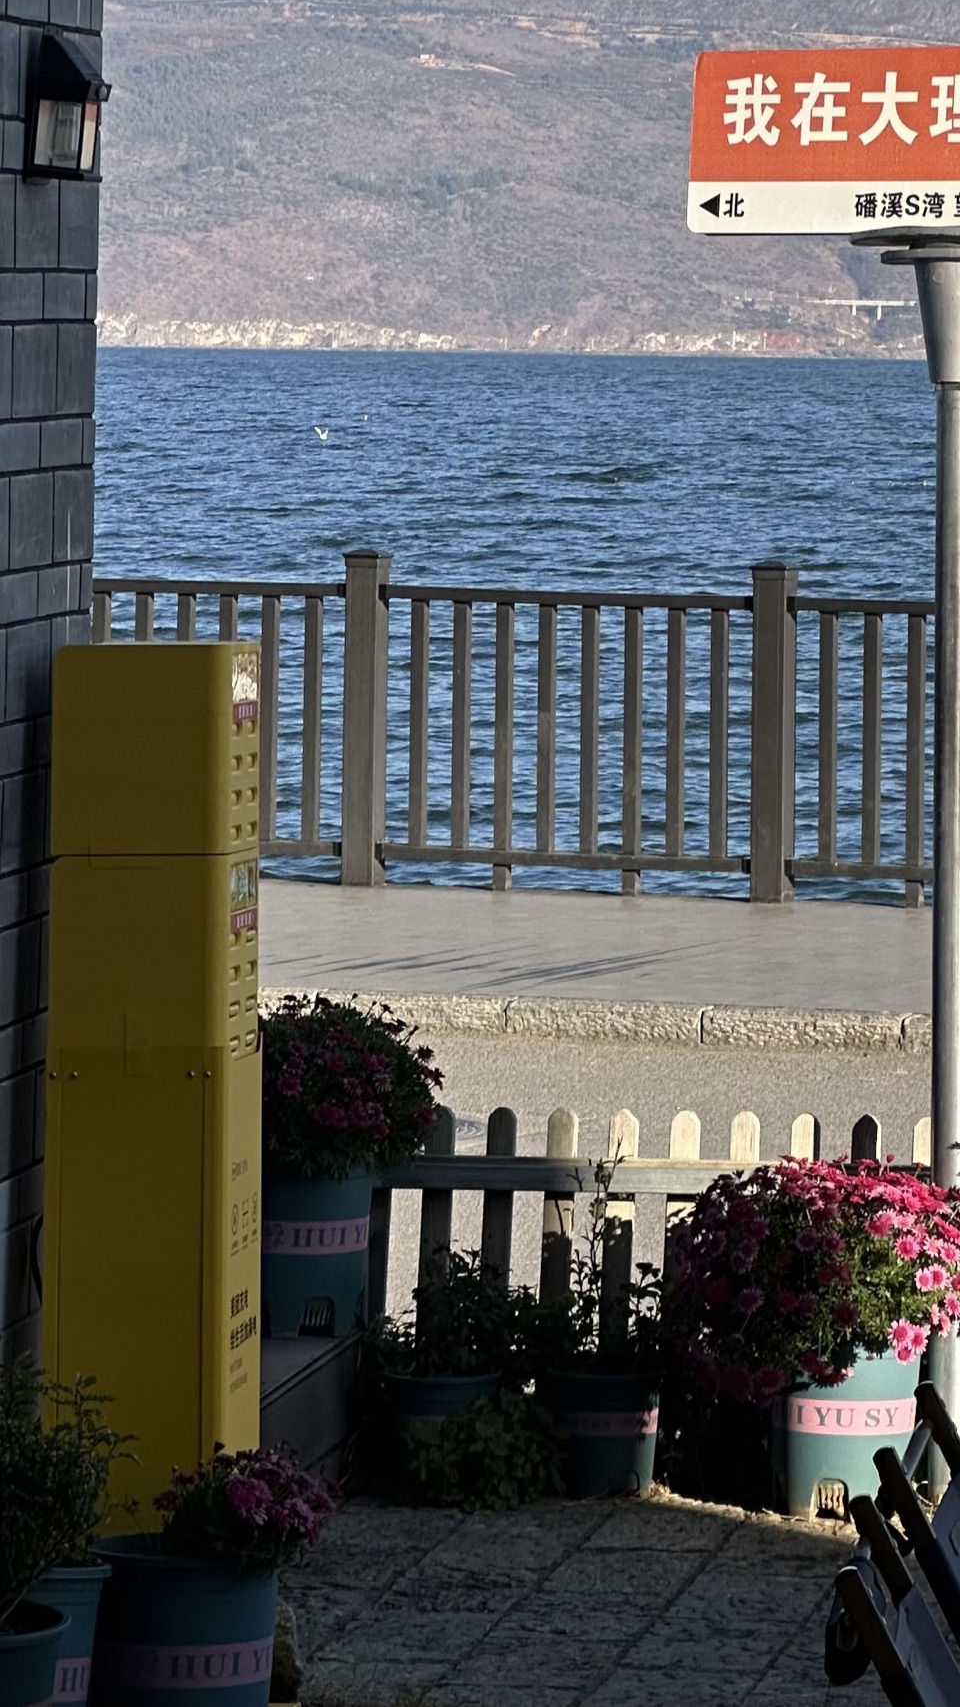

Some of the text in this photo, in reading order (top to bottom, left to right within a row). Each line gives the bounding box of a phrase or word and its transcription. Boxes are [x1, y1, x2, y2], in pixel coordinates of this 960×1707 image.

[724, 193, 745, 217] 北
[292, 1227, 346, 1248] HUI
[814, 1407, 856, 1428] YU
[864, 1407, 899, 1428] SY
[169, 1652, 241, 1679] HUI
